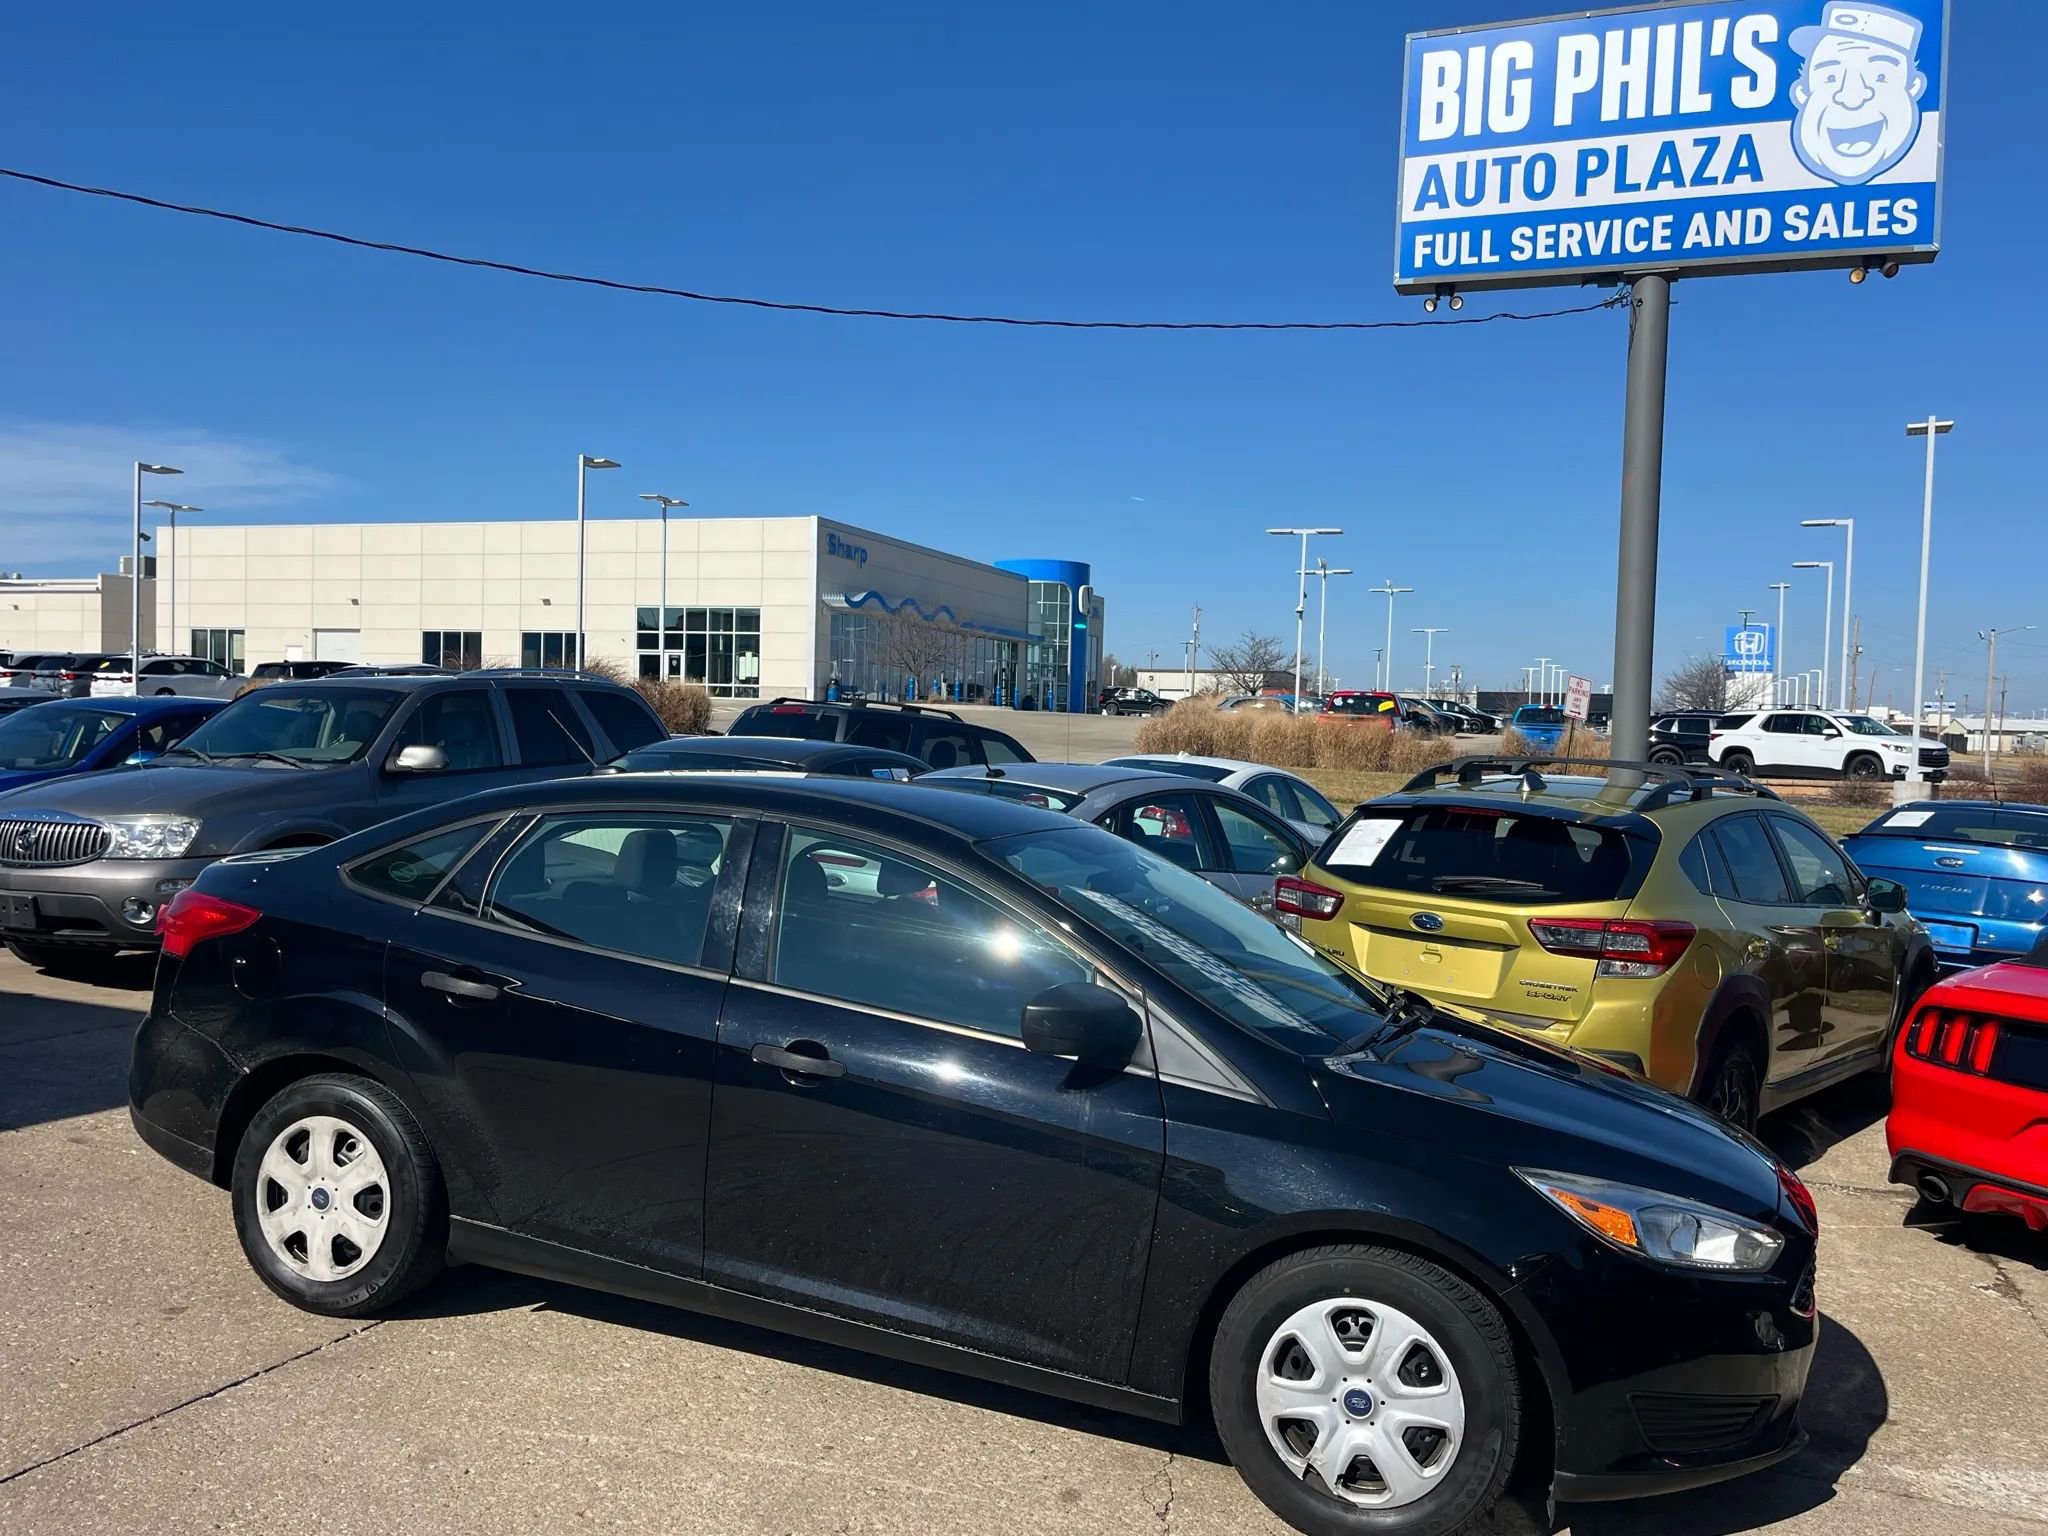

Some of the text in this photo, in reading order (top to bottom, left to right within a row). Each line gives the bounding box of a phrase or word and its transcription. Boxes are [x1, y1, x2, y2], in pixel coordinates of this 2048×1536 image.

[1418, 14, 1779, 142] BIG PHIL'S
[1413, 132, 1764, 213] AUTO PLAZA
[1414, 197, 1918, 269] FULL SERVICE AND SALES
[826, 533, 868, 569] Sharp
[1569, 686, 1589, 697] PARKING
[1920, 884, 1972, 894] FOCUS
[1519, 979, 1578, 992] CROSSTREK
[1527, 990, 1571, 1002] SPORT
